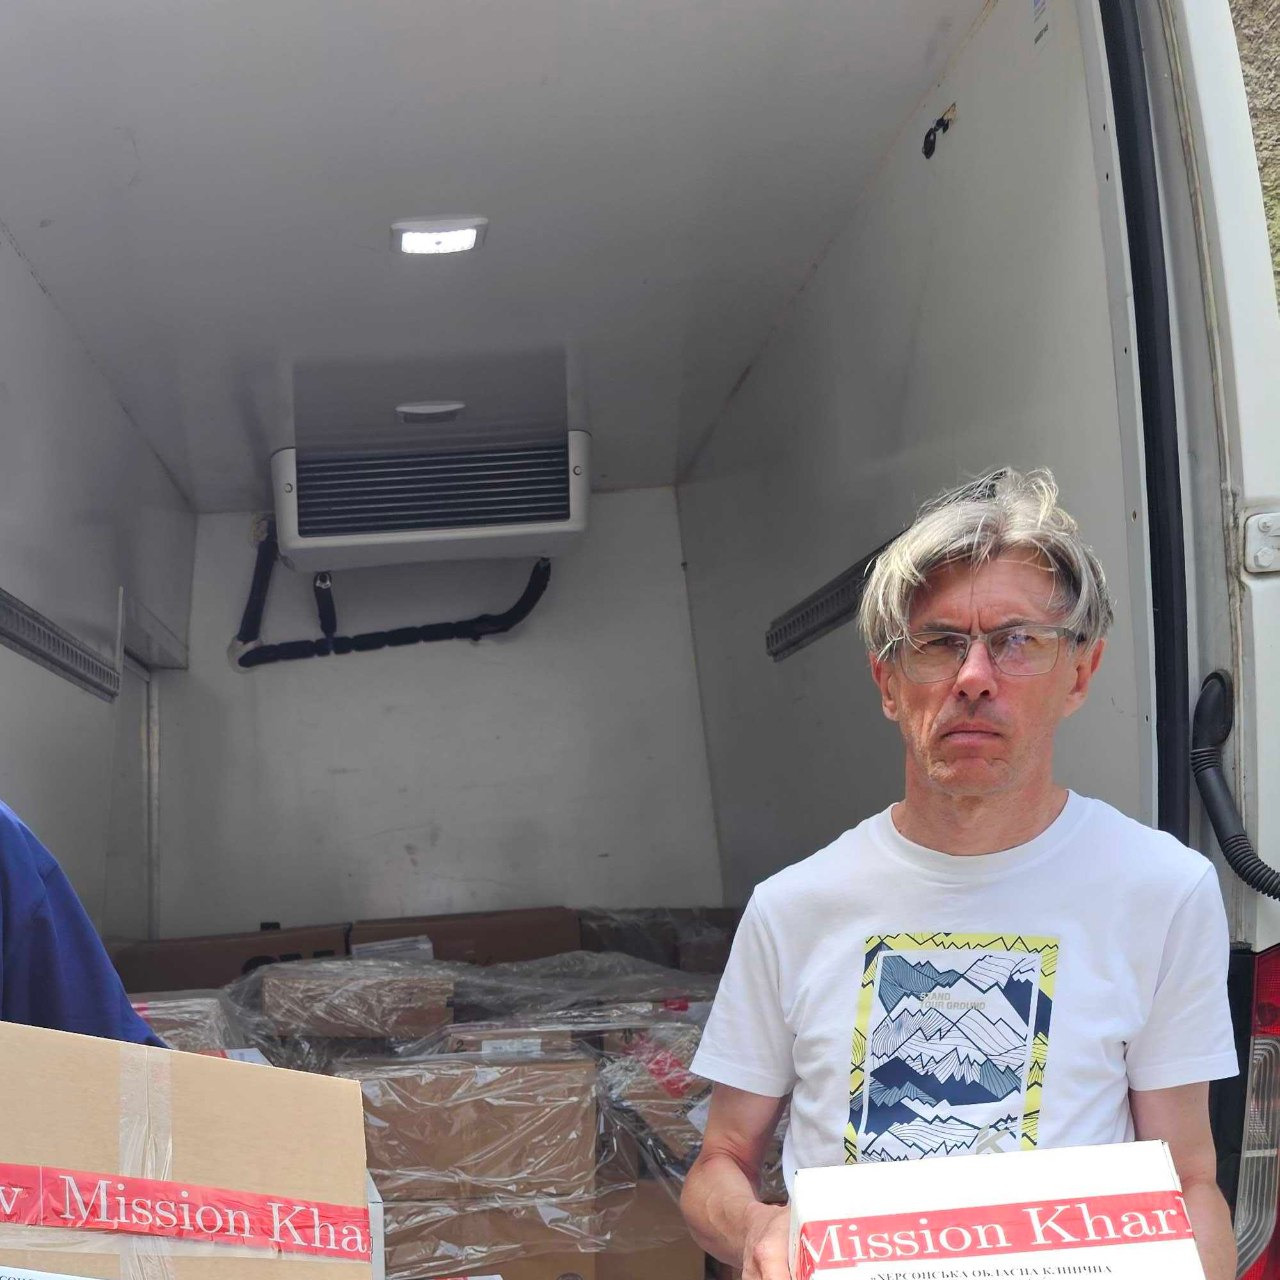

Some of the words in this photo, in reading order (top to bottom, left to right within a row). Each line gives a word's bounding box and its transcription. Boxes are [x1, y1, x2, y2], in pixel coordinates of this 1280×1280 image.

[920, 992, 951, 1001] STAND
[920, 1001, 945, 1009] YOUR
[946, 1002, 986, 1010] GROUND
[59, 1174, 254, 1238] Mission
[267, 1202, 371, 1254] Kha
[801, 1217, 1011, 1264] Mission
